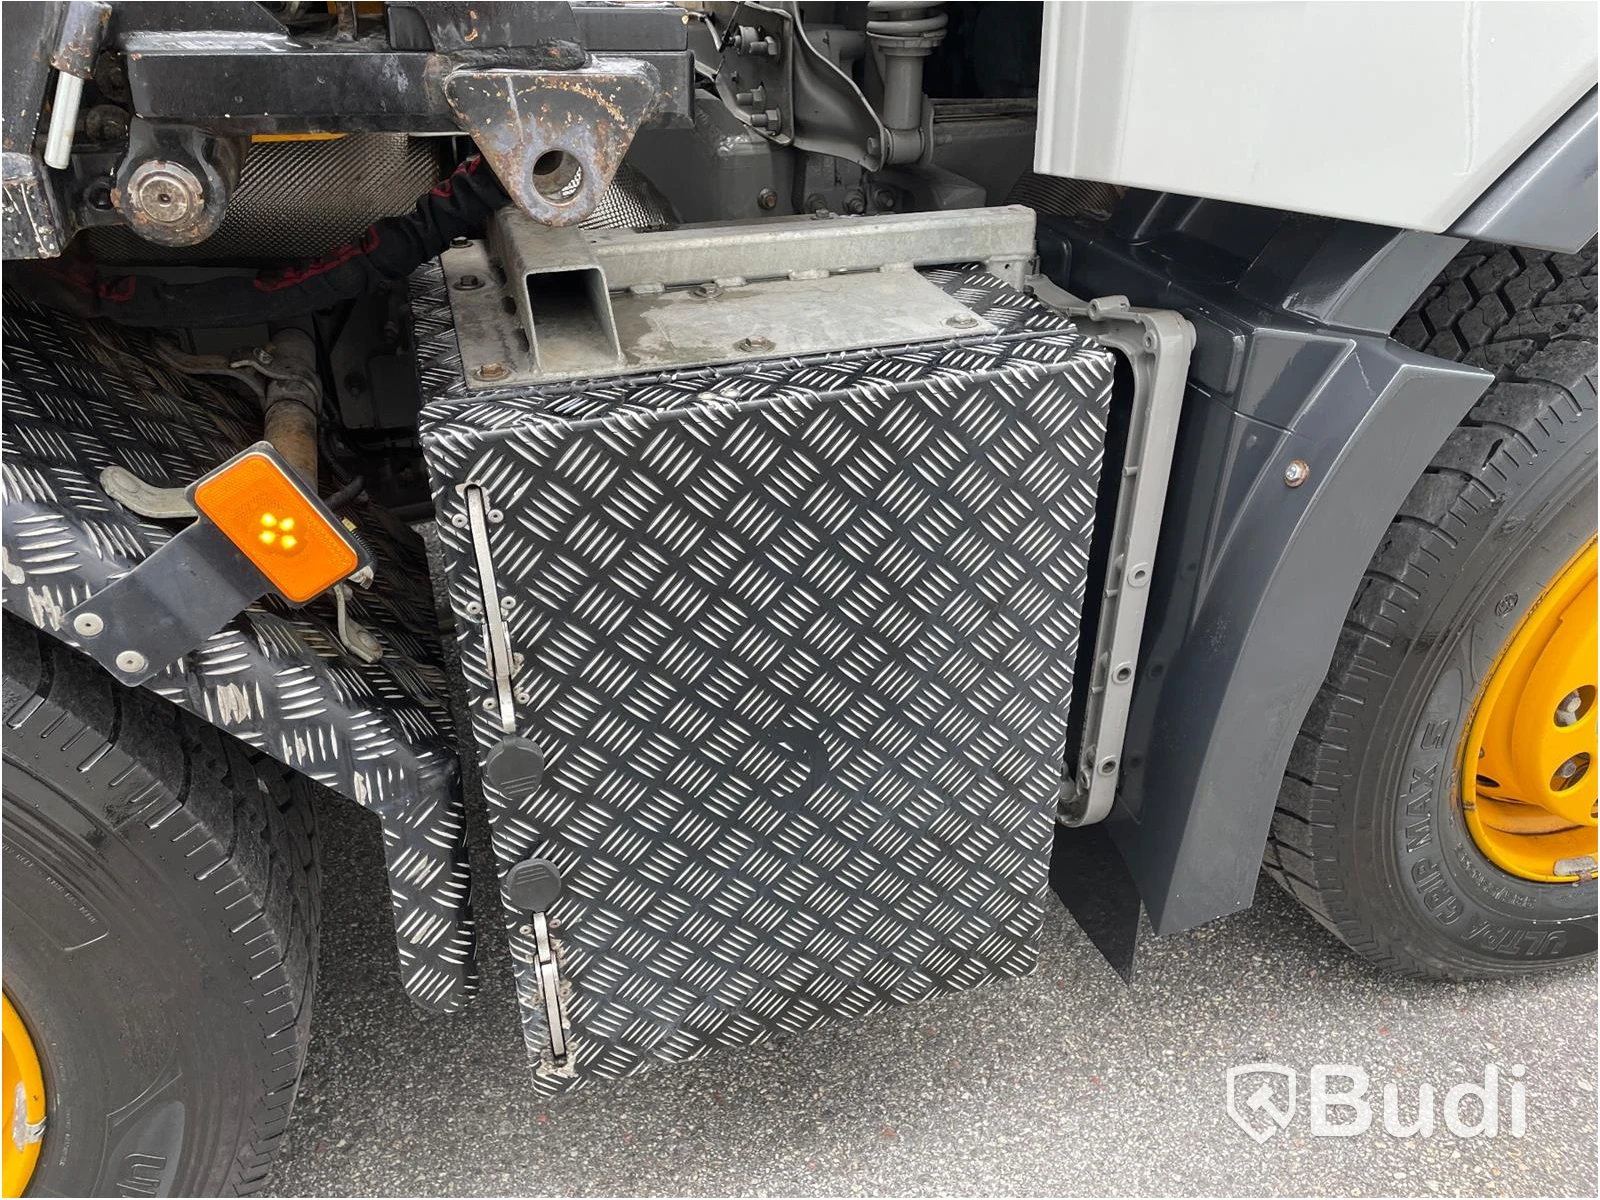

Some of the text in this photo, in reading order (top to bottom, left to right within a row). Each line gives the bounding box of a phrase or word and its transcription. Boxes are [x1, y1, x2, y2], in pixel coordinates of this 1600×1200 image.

[1404, 761, 1440, 853] MAX
[1410, 857, 1465, 926] GRIP
[1460, 917, 1568, 956] ULTRA
